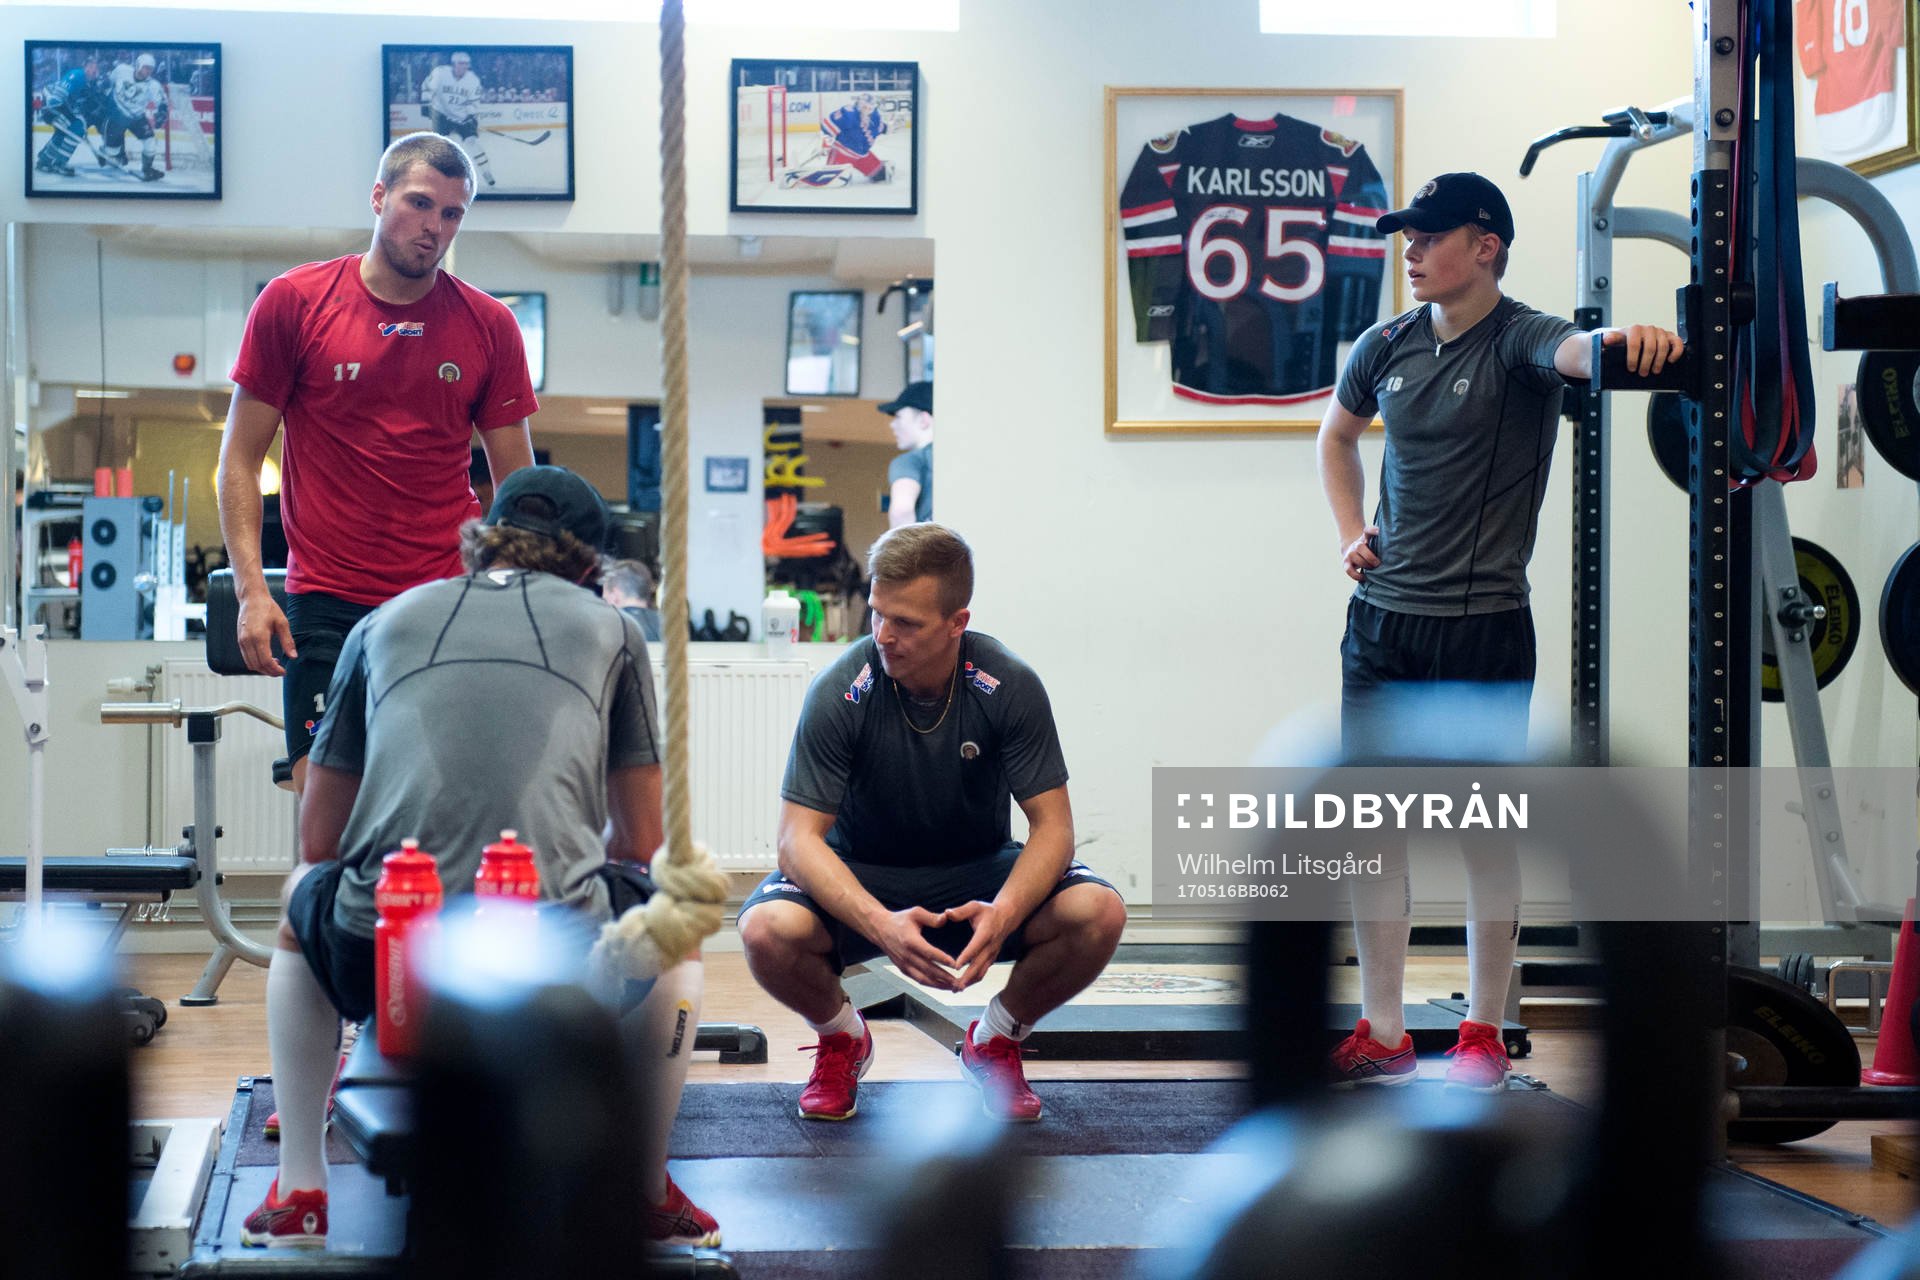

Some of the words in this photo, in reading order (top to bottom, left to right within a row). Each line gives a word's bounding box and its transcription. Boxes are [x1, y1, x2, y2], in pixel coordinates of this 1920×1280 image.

[1187, 165, 1325, 198] KARLSSON
[1186, 203, 1327, 302] 65
[334, 362, 361, 381] 17
[1824, 584, 1844, 645] ELEIKO
